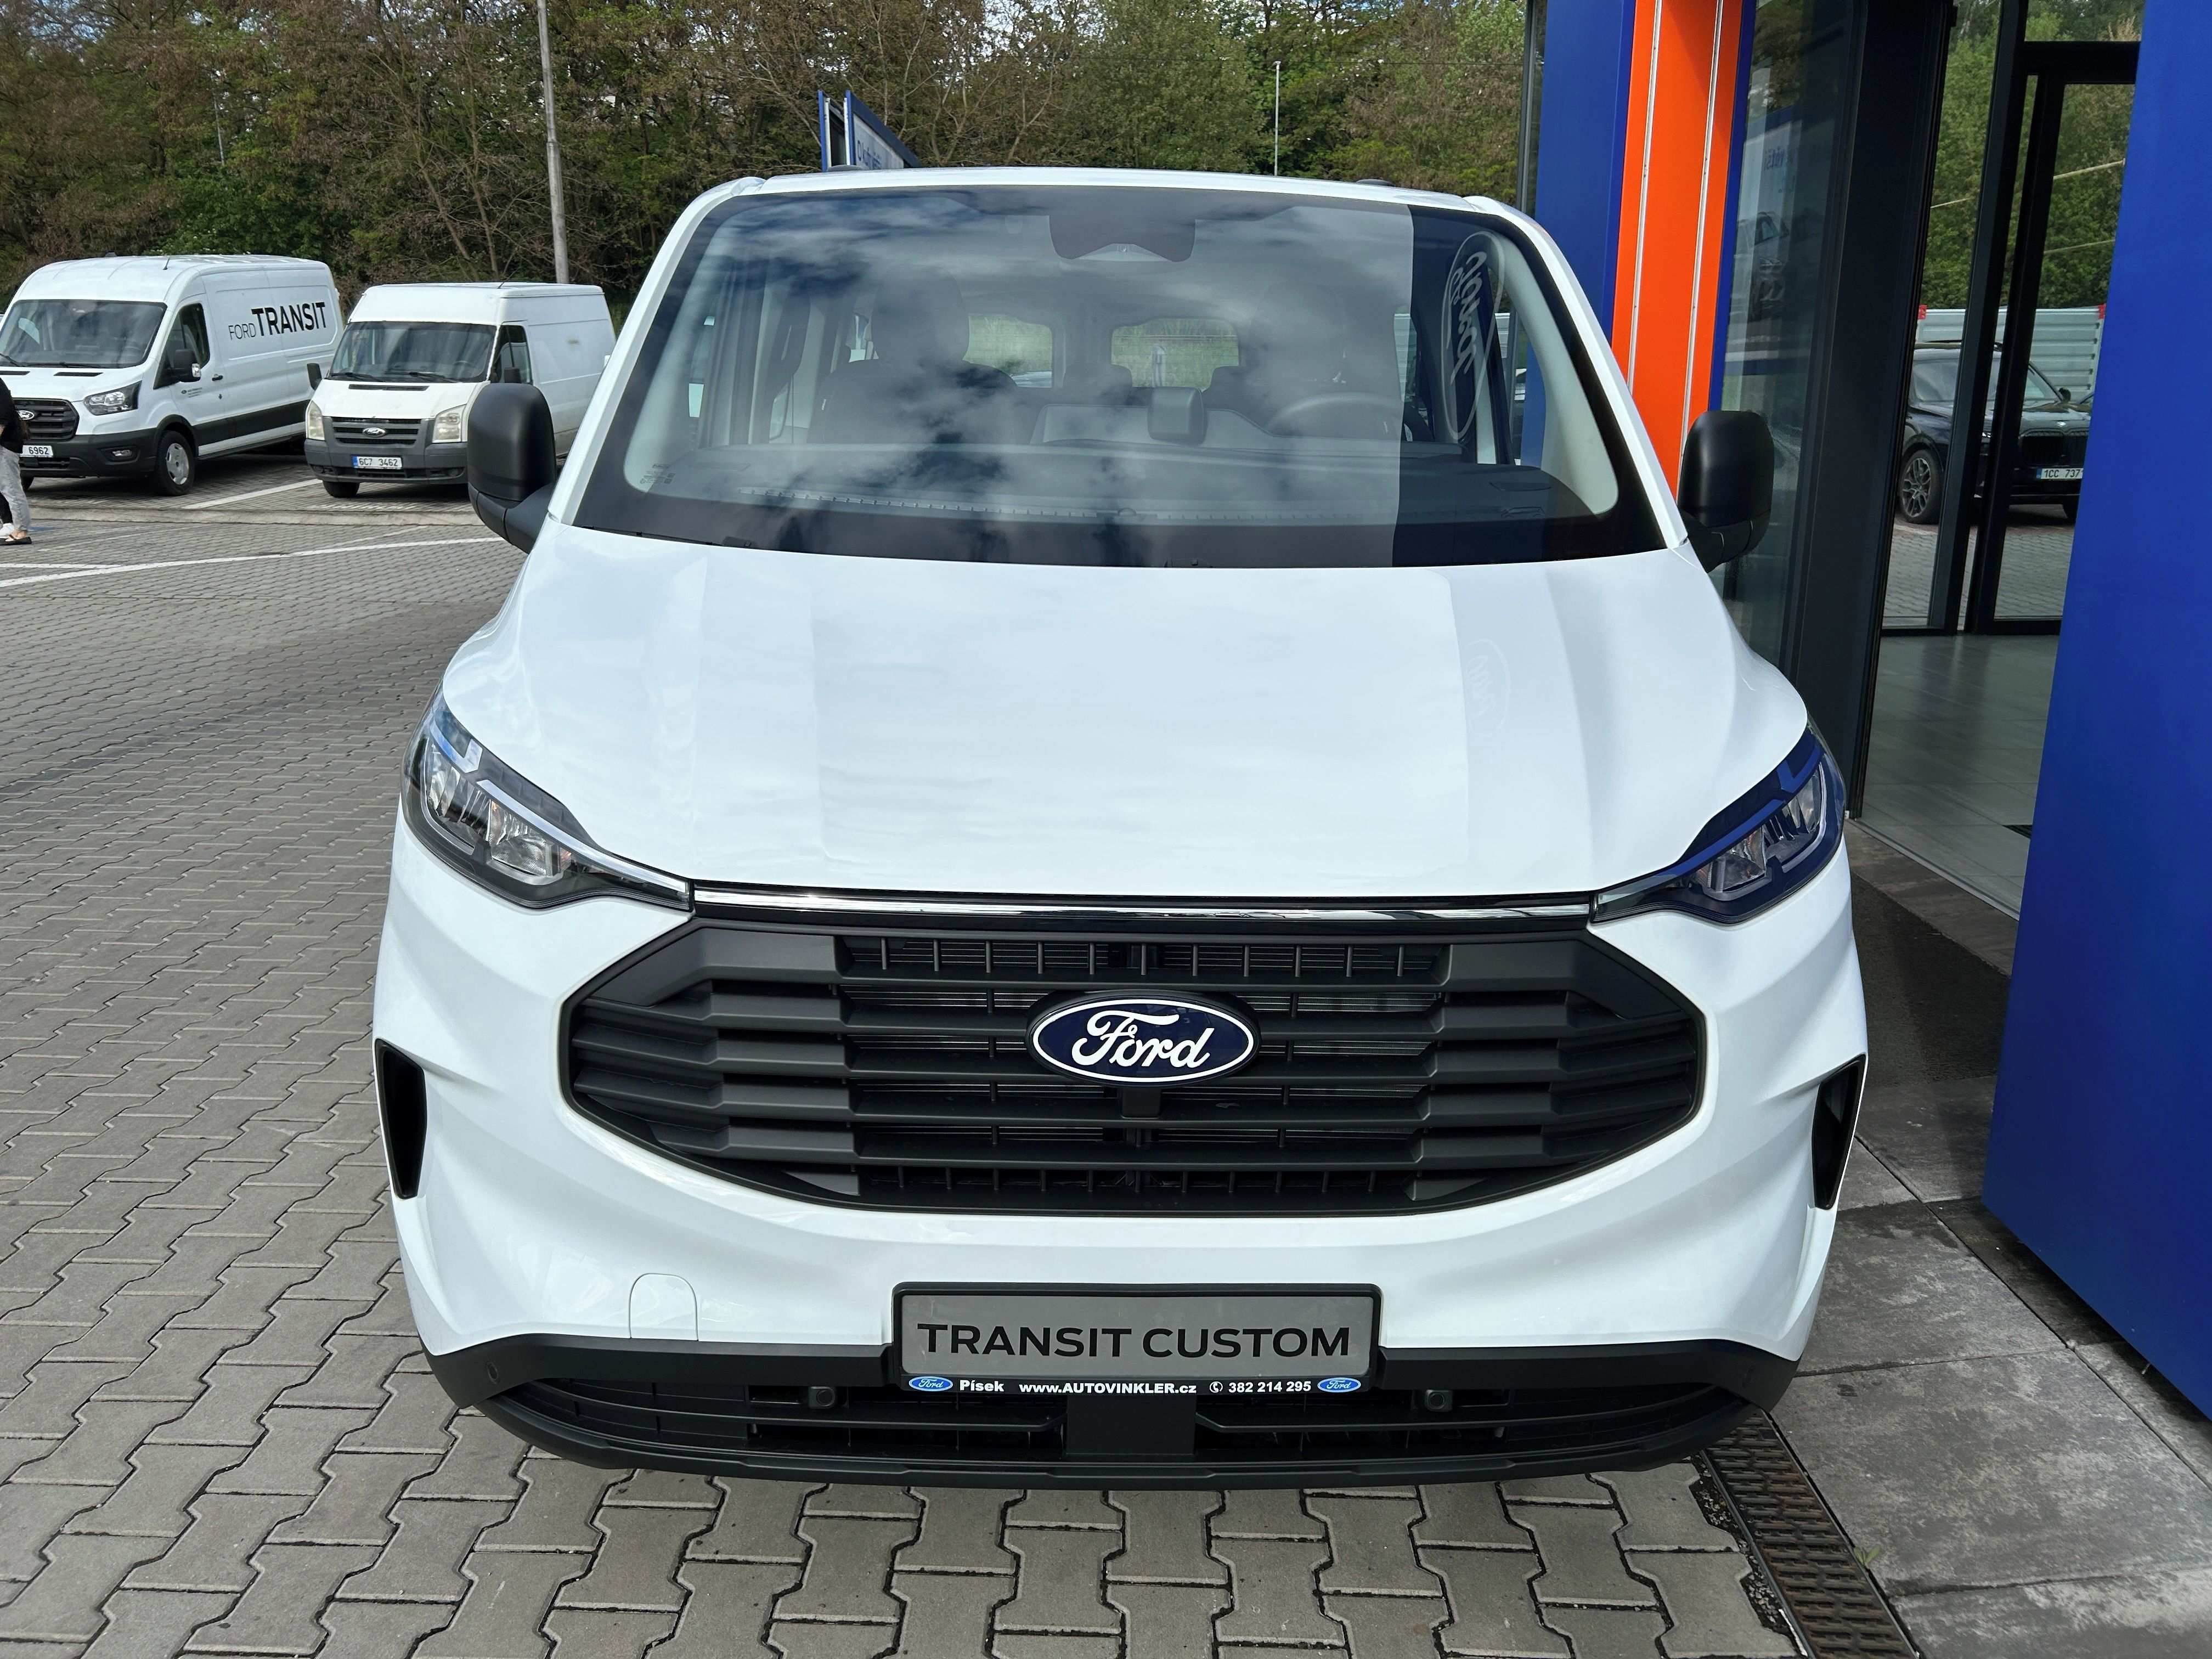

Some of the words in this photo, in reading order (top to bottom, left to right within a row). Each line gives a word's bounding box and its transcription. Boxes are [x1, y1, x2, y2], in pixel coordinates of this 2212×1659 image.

[228, 323, 256, 340] FORD
[251, 302, 326, 336] TRANSIT
[29, 447, 49, 455] 6962
[2044, 470, 2059, 478] 1CC
[2065, 469, 2084, 478] 737
[1071, 1010, 1215, 1068] Ford
[917, 1323, 1132, 1357] TRANSIT
[1142, 1327, 1350, 1358] CUSTOM
[960, 1380, 1005, 1392] Písek
[1019, 1382, 1197, 1394] www.AUTOVINKLER.cz
[1228, 1382, 1254, 1393] 382
[1257, 1381, 1283, 1392] 214
[1286, 1381, 1311, 1392] 295
